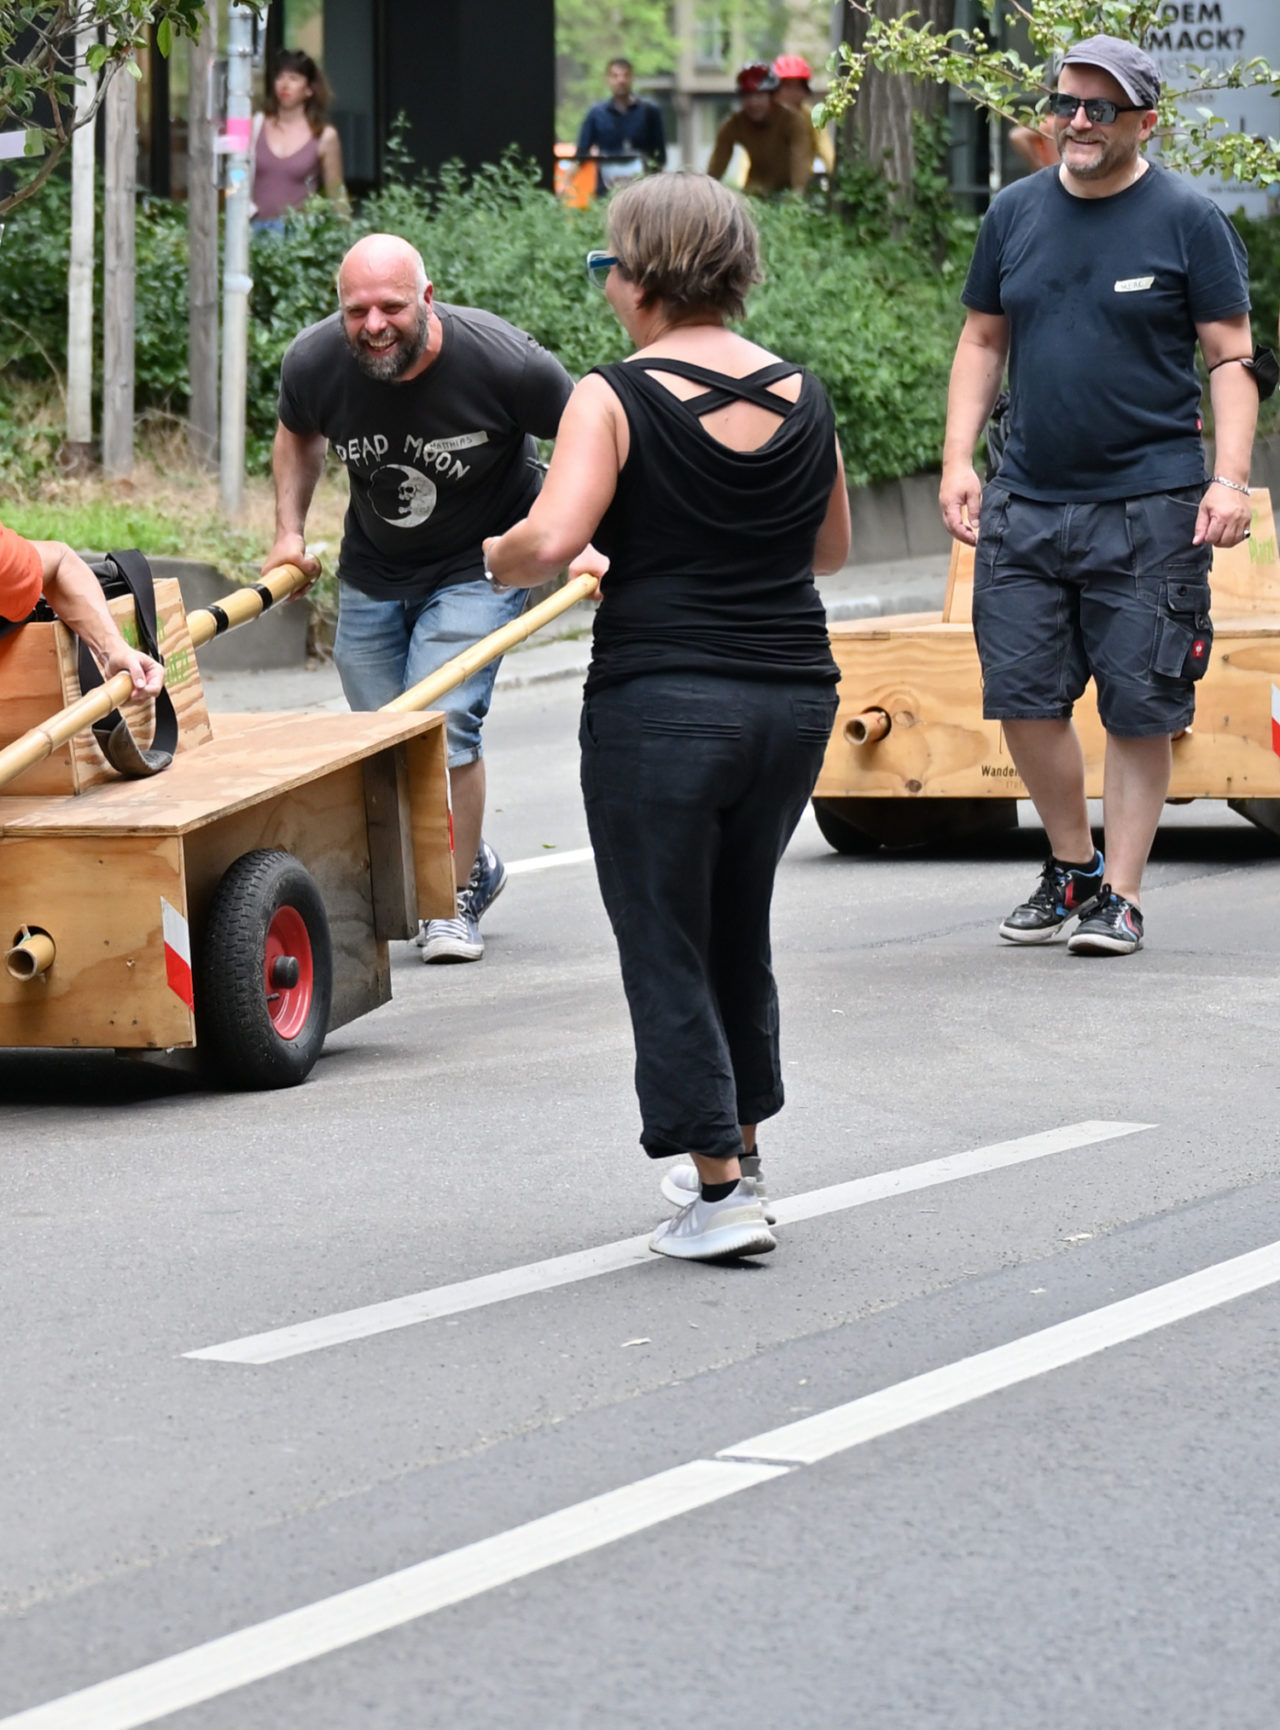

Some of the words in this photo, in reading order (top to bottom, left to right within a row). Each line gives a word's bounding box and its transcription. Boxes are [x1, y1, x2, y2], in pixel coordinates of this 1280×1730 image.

[1162, 2, 1223, 24] DEM
[1147, 27, 1246, 52] MACK?
[429, 436, 473, 450] MATTHIAS
[335, 433, 389, 467] DEAD
[404, 433, 471, 480] MOON
